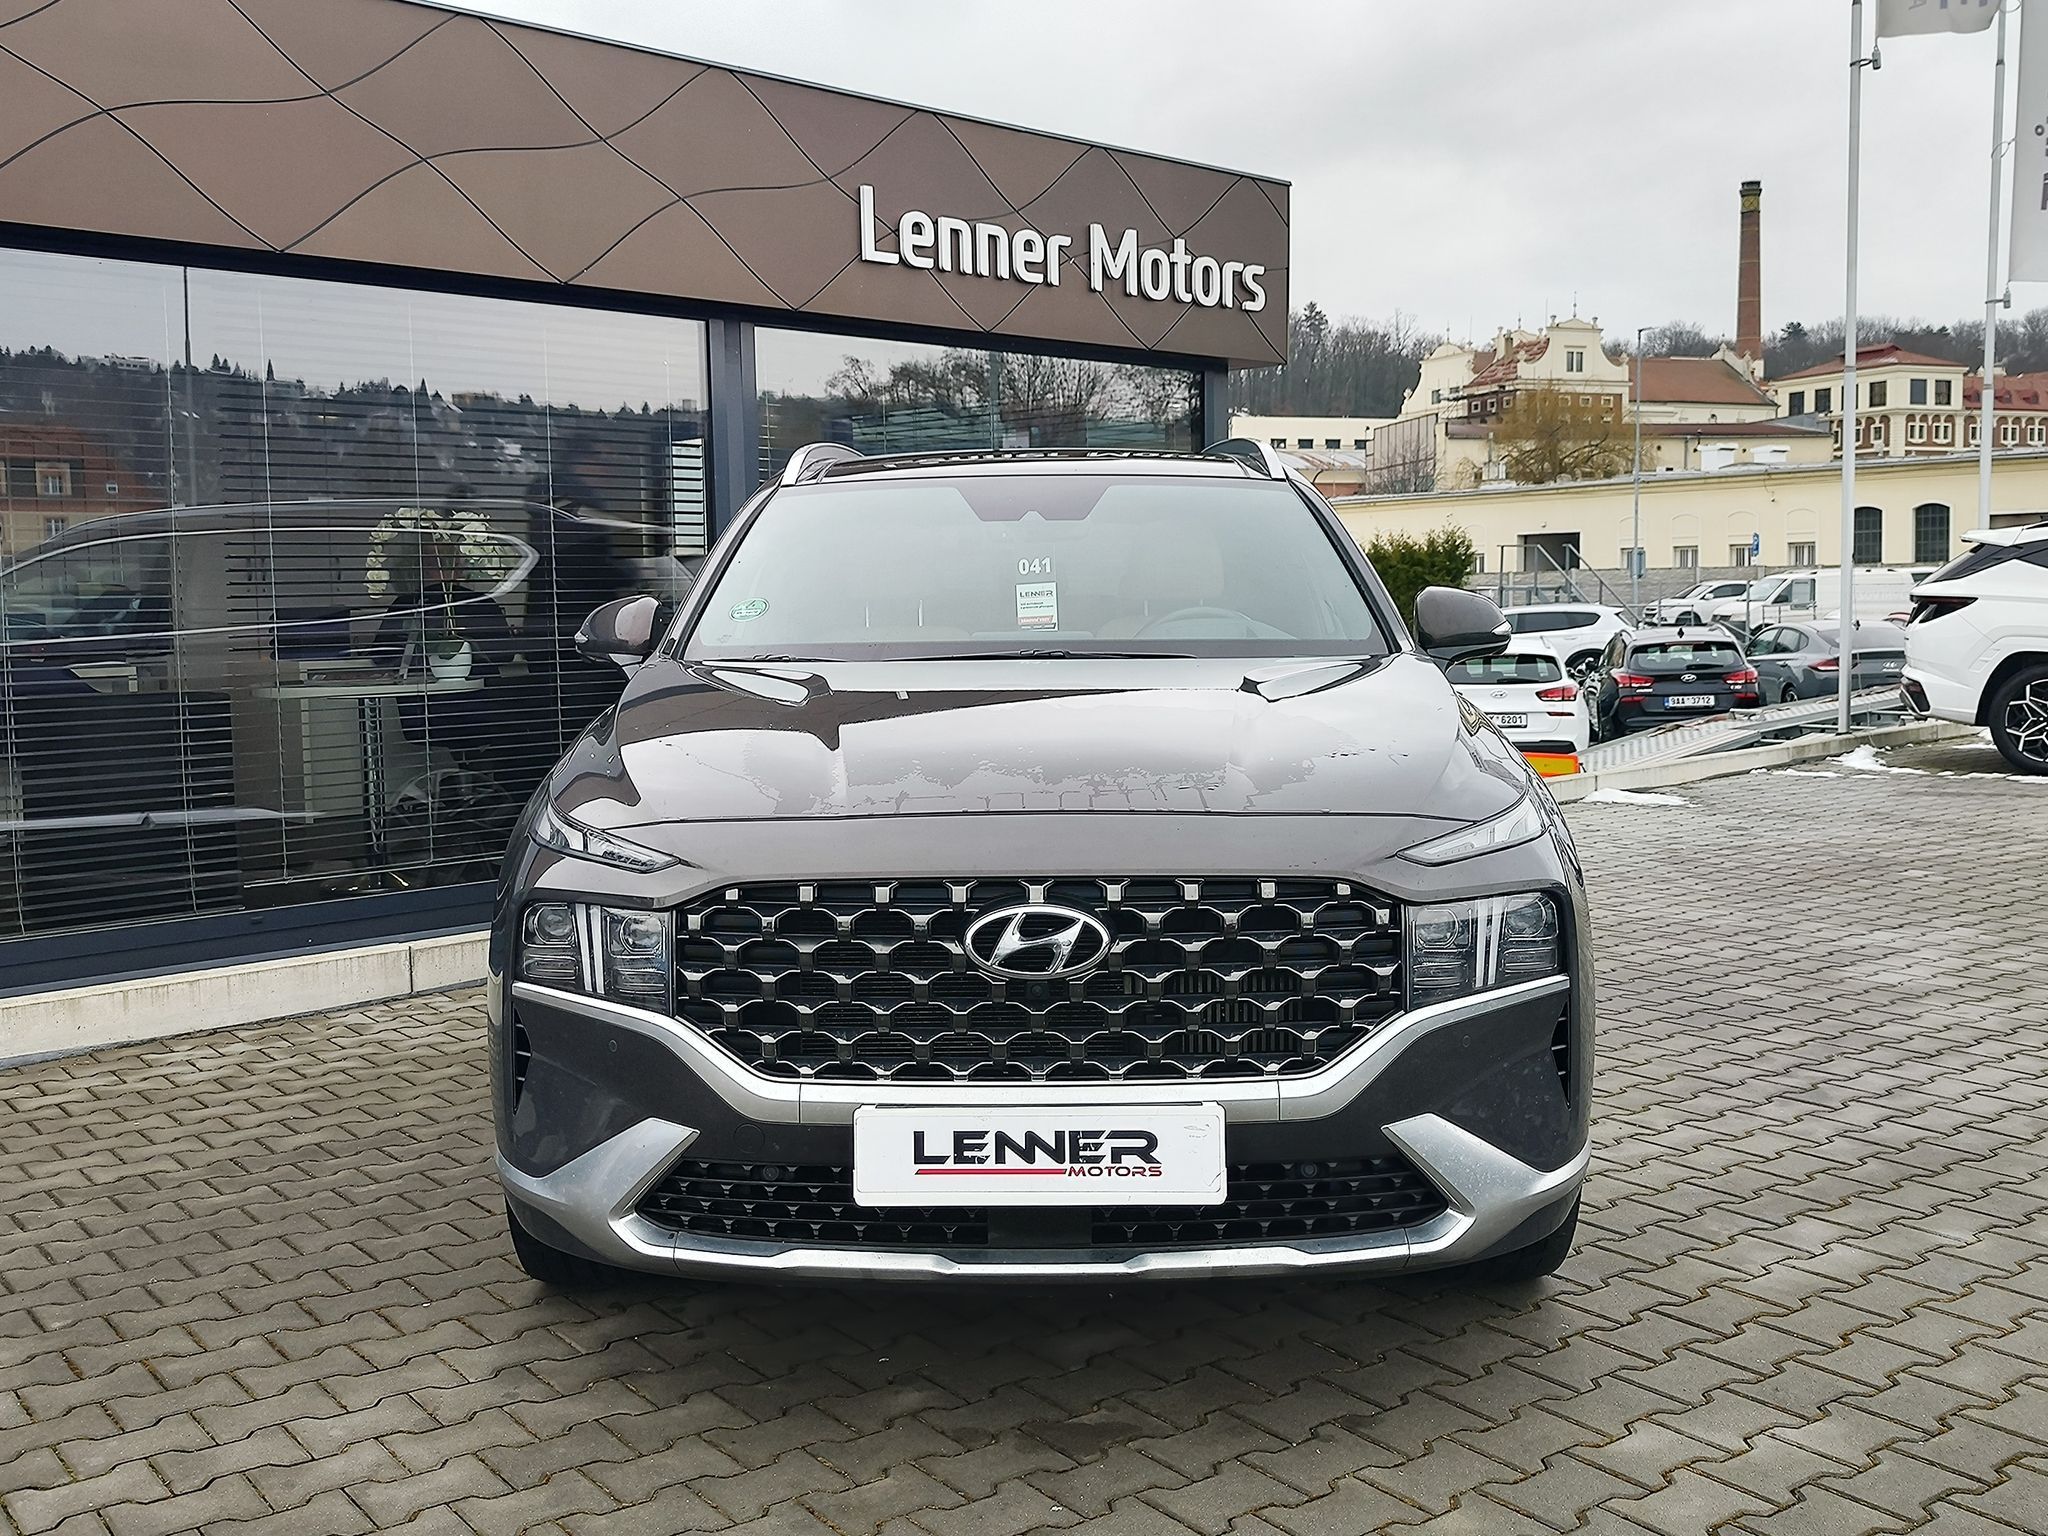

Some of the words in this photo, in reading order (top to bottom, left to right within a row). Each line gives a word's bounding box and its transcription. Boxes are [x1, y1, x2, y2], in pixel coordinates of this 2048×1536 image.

[858, 184, 1072, 287] Lenner
[1089, 222, 1266, 312] Motors
[1018, 557, 1052, 575] 041
[1691, 696, 1711, 705] 3712
[1501, 715, 1523, 724] 6201
[913, 1130, 1163, 1165] LENNER
[1067, 1165, 1163, 1178] MOTORS
